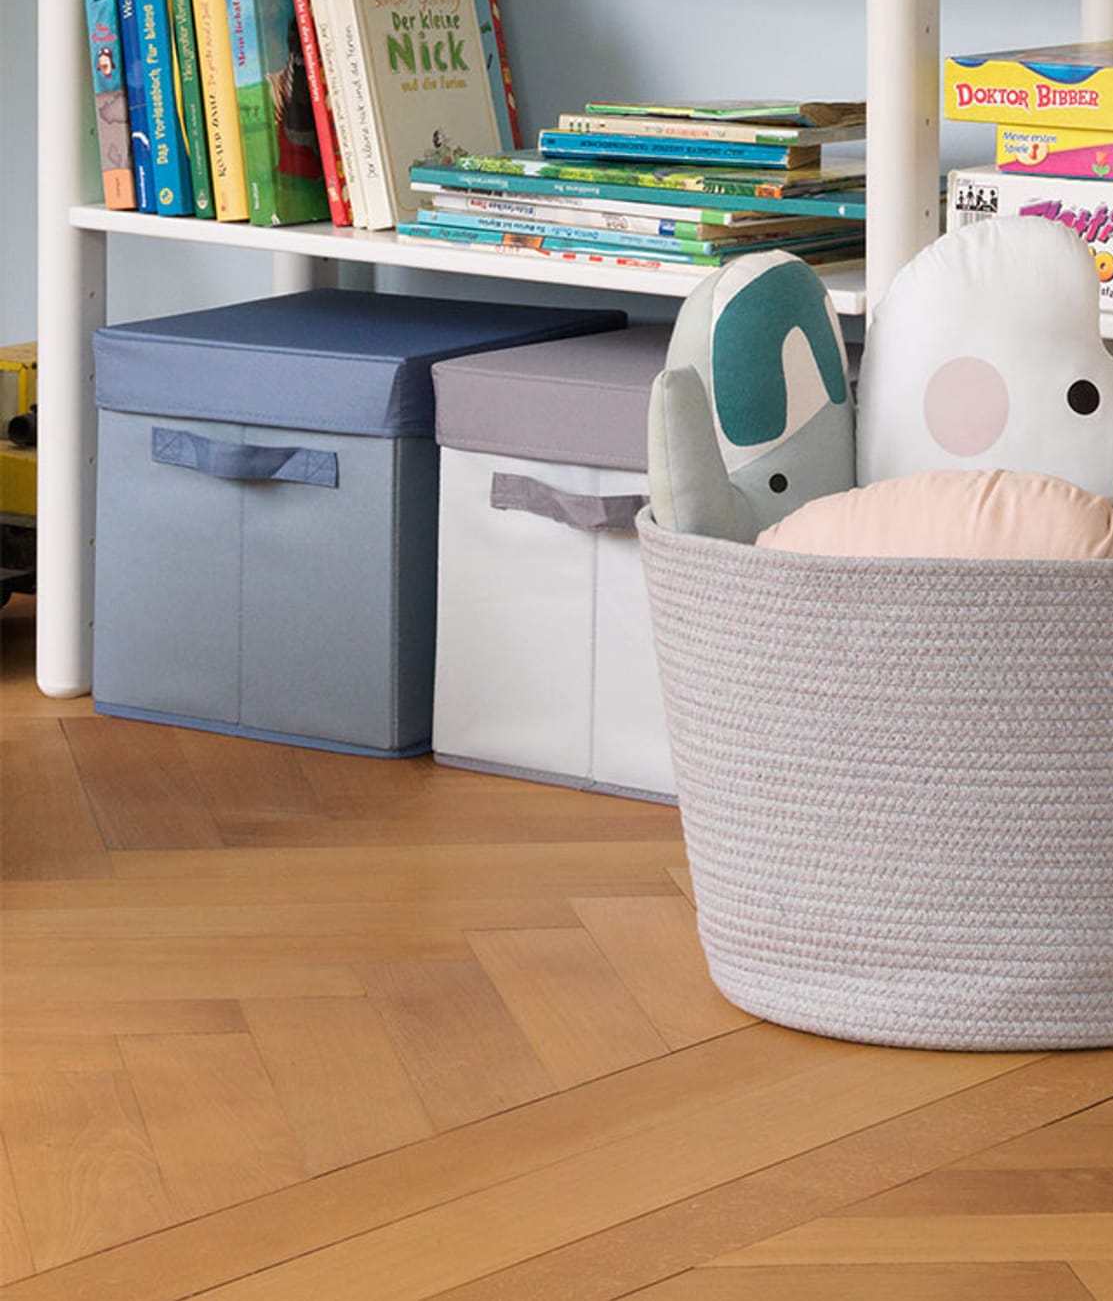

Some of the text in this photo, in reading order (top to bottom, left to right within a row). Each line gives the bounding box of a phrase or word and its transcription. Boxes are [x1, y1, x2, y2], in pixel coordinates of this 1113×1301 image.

[391, 8, 461, 31] Der kleine
[386, 30, 471, 75] Nick
[956, 83, 1030, 110] DOKTOR
[1036, 84, 1100, 107] BIBBER
[1003, 131, 1057, 143] Meine ersten
[1004, 143, 1029, 154] Spiele
[157, 143, 170, 166] Das
